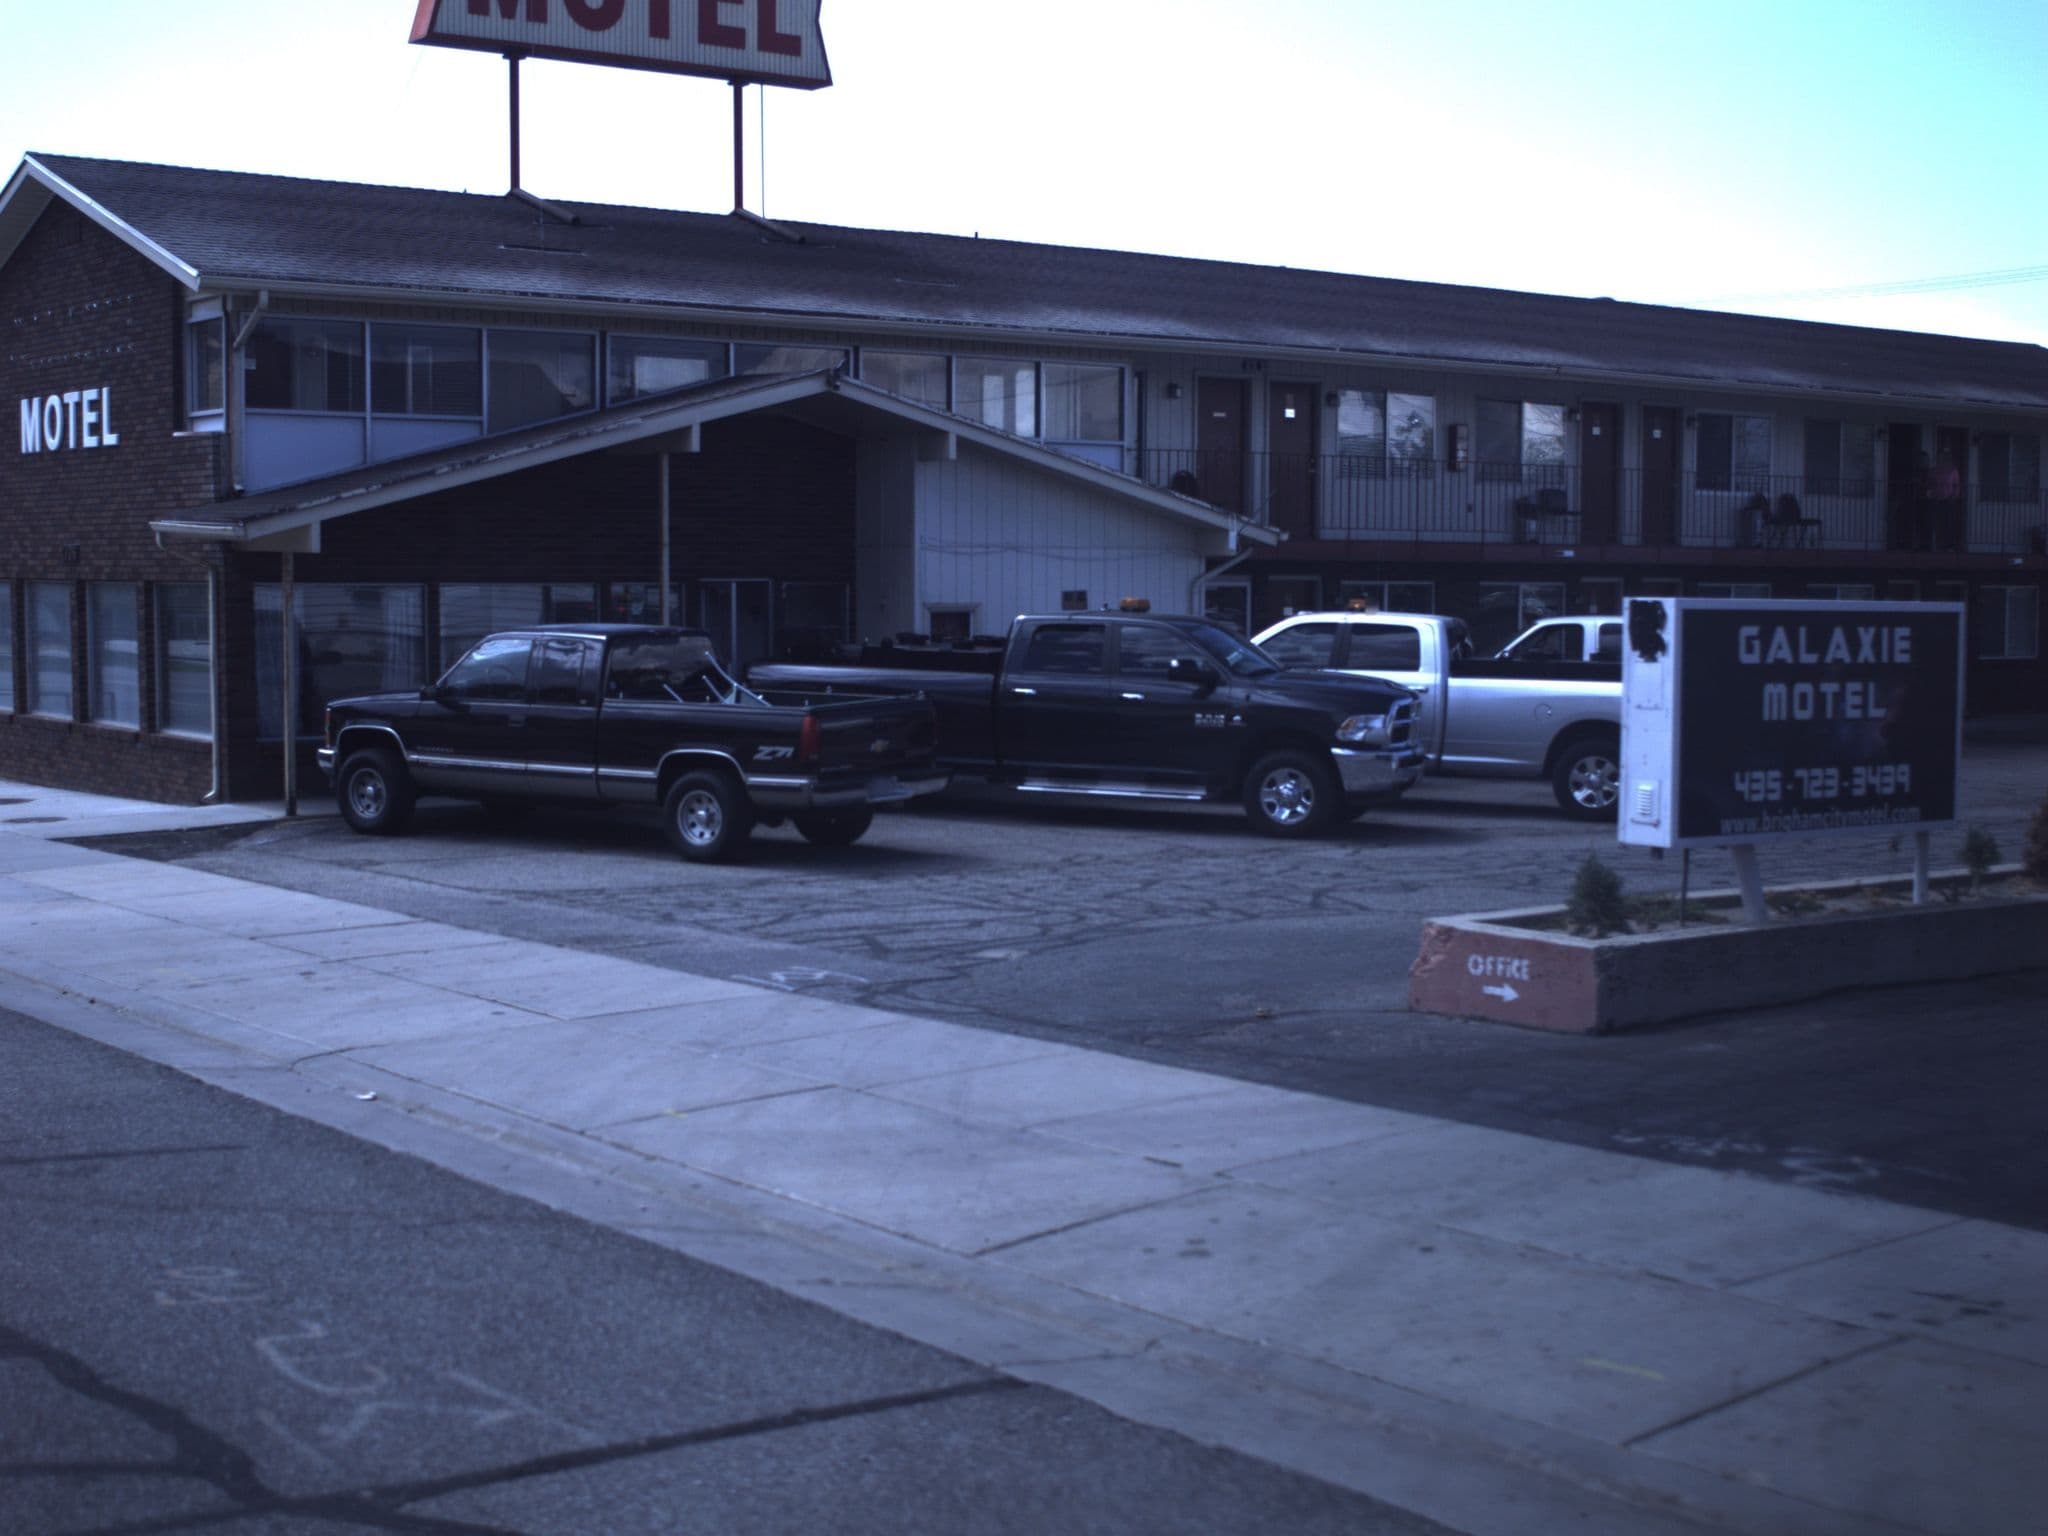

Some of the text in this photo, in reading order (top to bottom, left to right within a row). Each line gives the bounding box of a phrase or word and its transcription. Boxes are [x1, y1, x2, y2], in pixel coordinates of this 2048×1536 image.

[20, 386, 120, 454] MOTEL
[1738, 624, 1912, 664] GALAXIE
[1762, 681, 1887, 721] MOTEL
